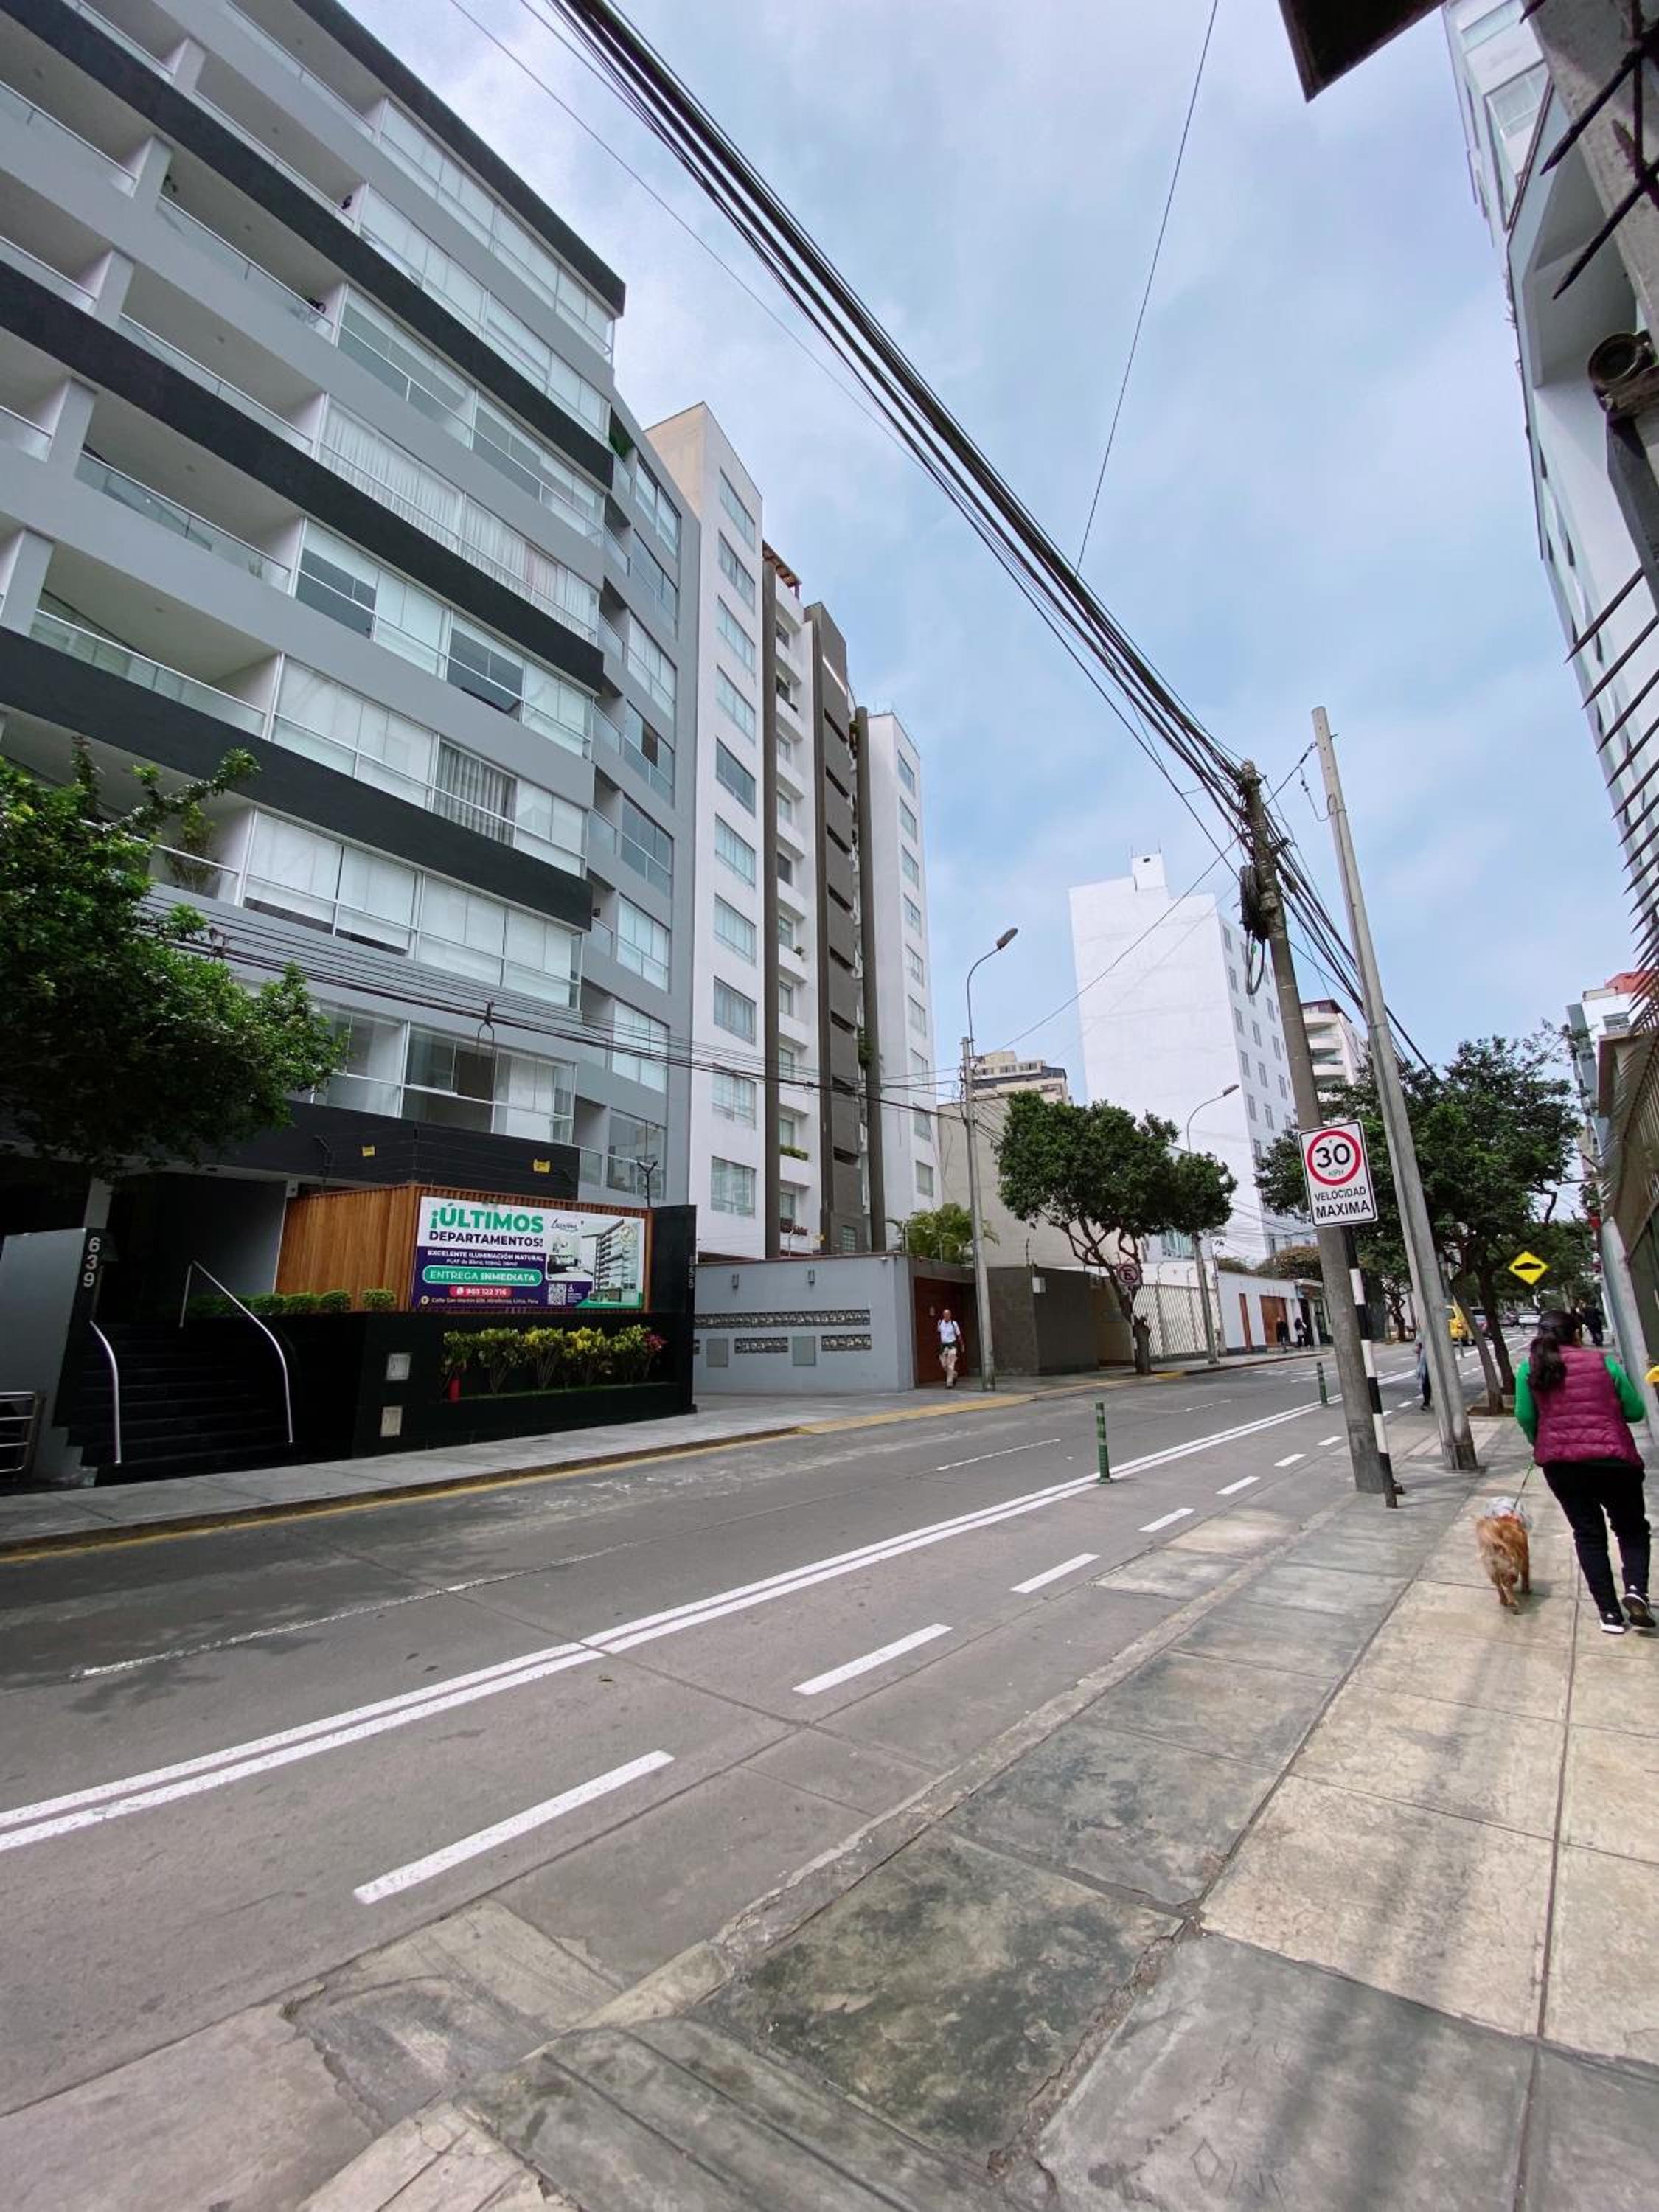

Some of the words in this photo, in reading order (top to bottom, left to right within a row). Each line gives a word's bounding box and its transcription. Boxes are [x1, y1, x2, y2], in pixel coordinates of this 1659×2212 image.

[1315, 1144, 1351, 1169] 30
[1314, 1186, 1367, 1201] VELOCIDAD
[430, 1203, 543, 1234] ¡ÚLTIMOS
[1315, 1200, 1371, 1219] MAXIMA
[428, 1231, 543, 1248] DEPARTAMENTOS!
[83, 1237, 101, 1288] 639
[427, 1249, 468, 1258] EXCELENTE
[468, 1251, 514, 1260] ILUMINACIÓN
[430, 1270, 479, 1281] ENTREGA
[480, 1272, 536, 1281] INMEDIATA
